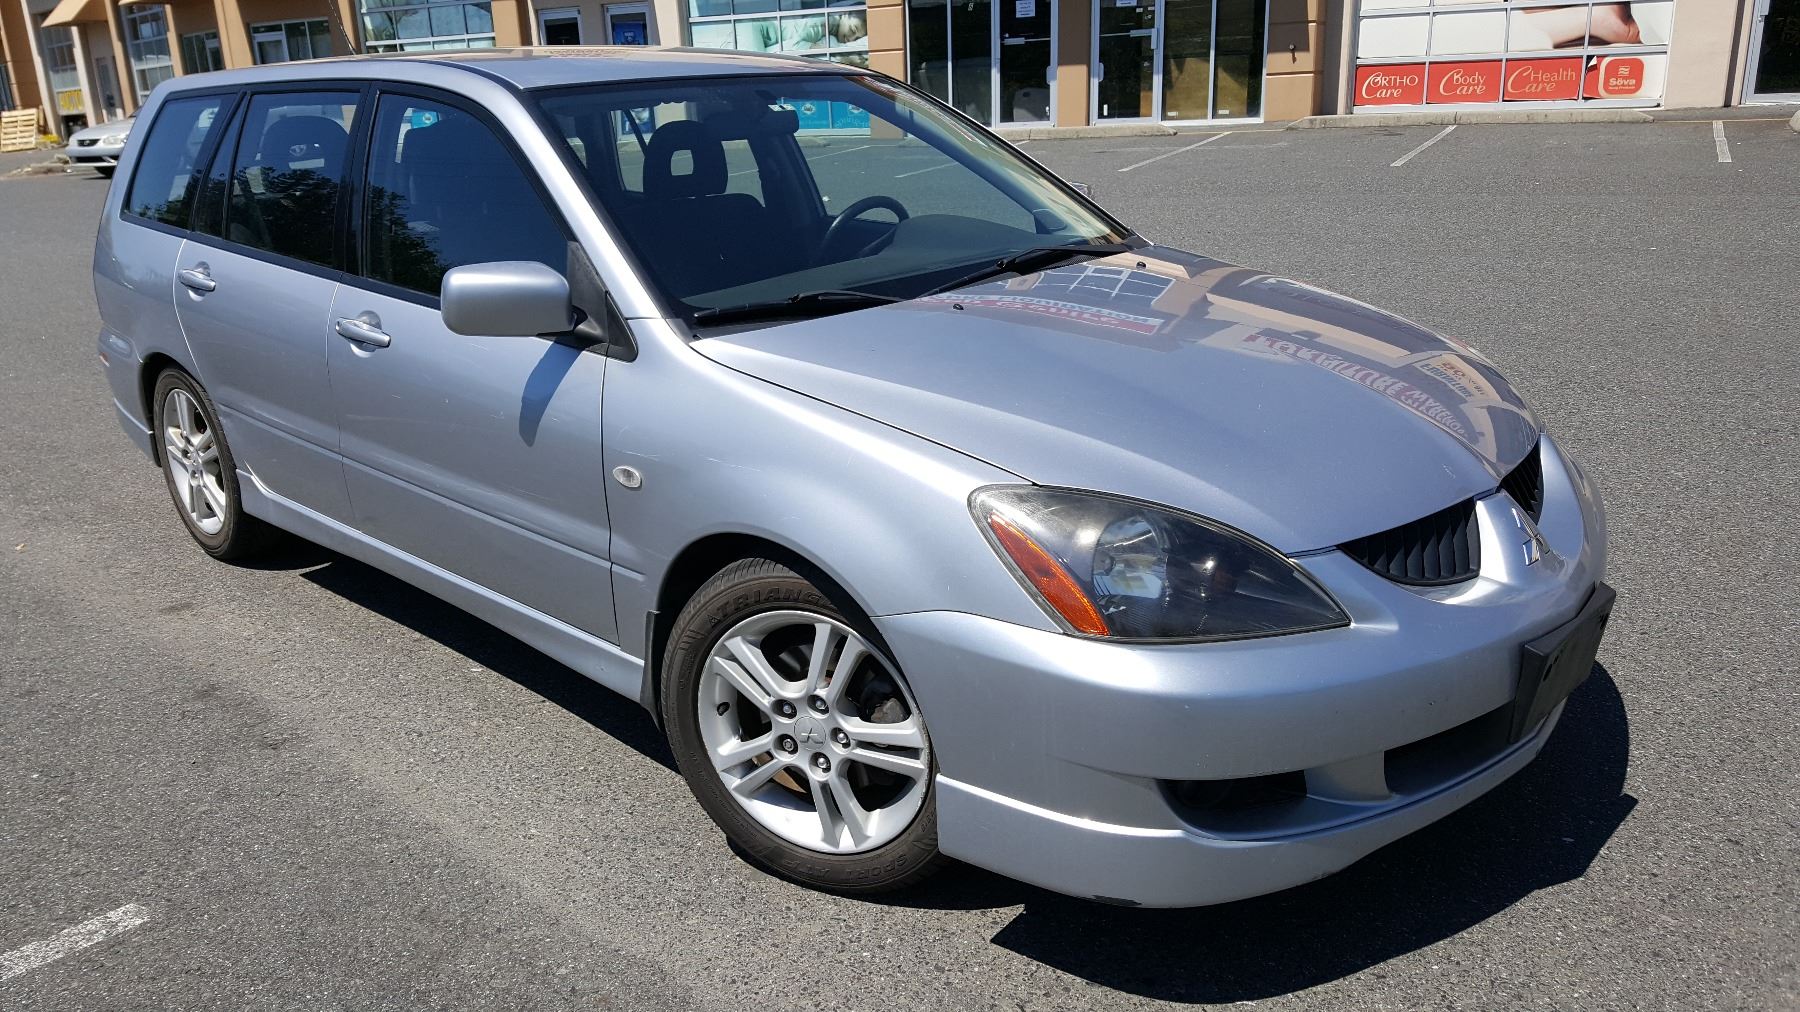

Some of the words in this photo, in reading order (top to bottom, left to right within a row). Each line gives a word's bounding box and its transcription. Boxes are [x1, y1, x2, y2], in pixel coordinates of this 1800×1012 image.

[1362, 71, 1402, 98] Care
[1370, 75, 1419, 87] ORTHO
[1440, 68, 1486, 96] Care
[1453, 71, 1486, 86] Body
[1507, 65, 1557, 93] Care
[1530, 67, 1576, 81] Health
[1609, 77, 1636, 87] Söva
[715, 586, 822, 619] TRIANG
